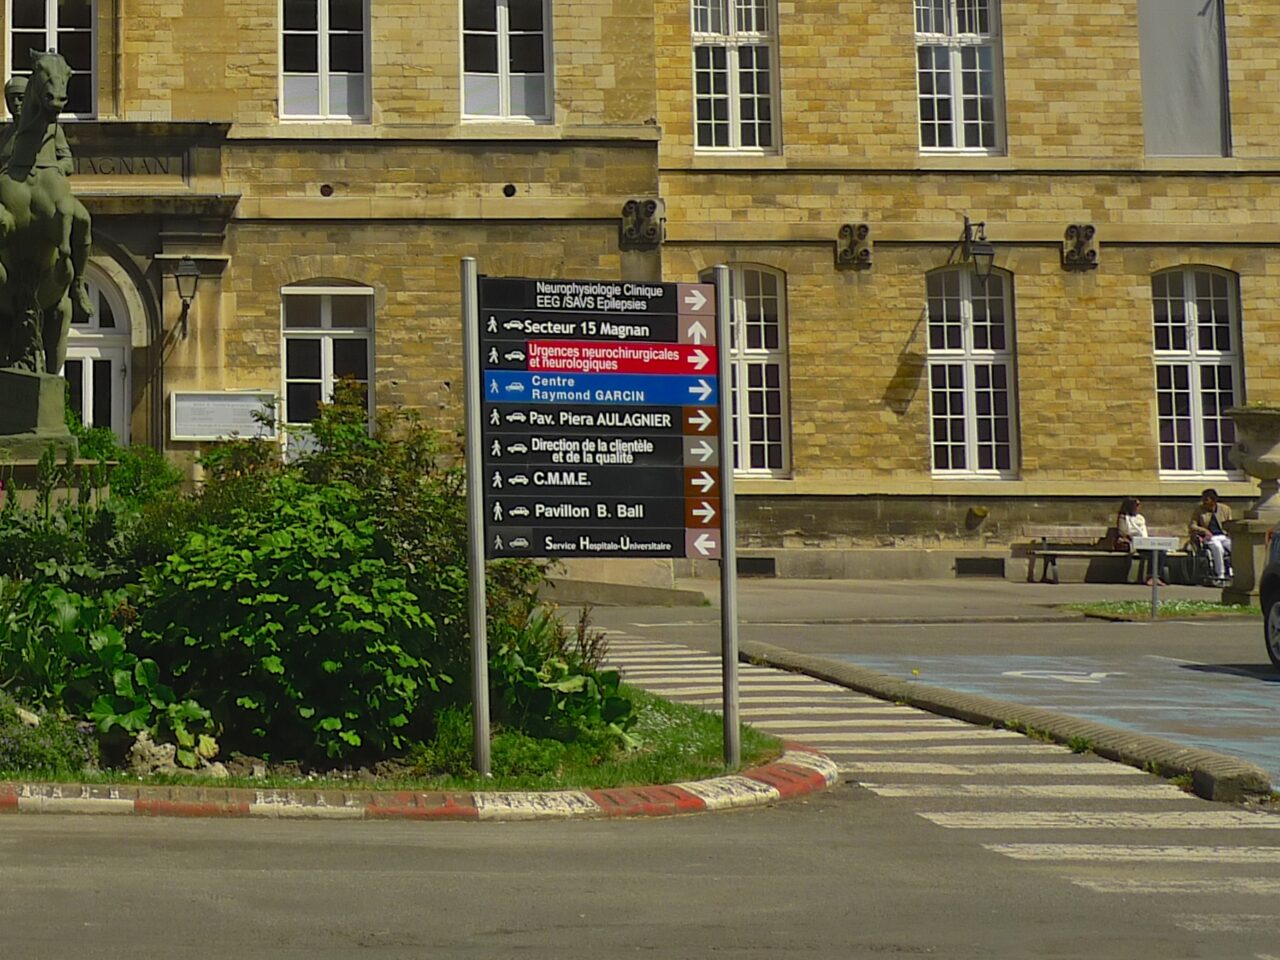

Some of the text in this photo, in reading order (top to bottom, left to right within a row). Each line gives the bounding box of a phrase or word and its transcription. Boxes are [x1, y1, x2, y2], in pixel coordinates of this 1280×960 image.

[73, 156, 169, 175] AGNAN
[536, 282, 663, 298] Neurophysiologie Clinique
[537, 296, 560, 307] EEG
[597, 297, 647, 311] Epilepsies
[525, 320, 649, 338] Secteur 15 Magnan
[529, 344, 679, 361] Urgences neurochirurgicales
[530, 358, 618, 372] et neurologiques
[532, 376, 575, 386] Centre
[532, 389, 645, 401] Raymond GARCIN
[530, 412, 671, 427] Pav. Piera AULAGNIER
[532, 438, 653, 452] Direction de la clientèle
[552, 452, 563, 463] et
[566, 451, 580, 463] de
[583, 452, 593, 463] la
[533, 471, 591, 485] C.M.M.E.
[535, 504, 643, 518] Pavillon B. Ball
[545, 537, 576, 550] Service
